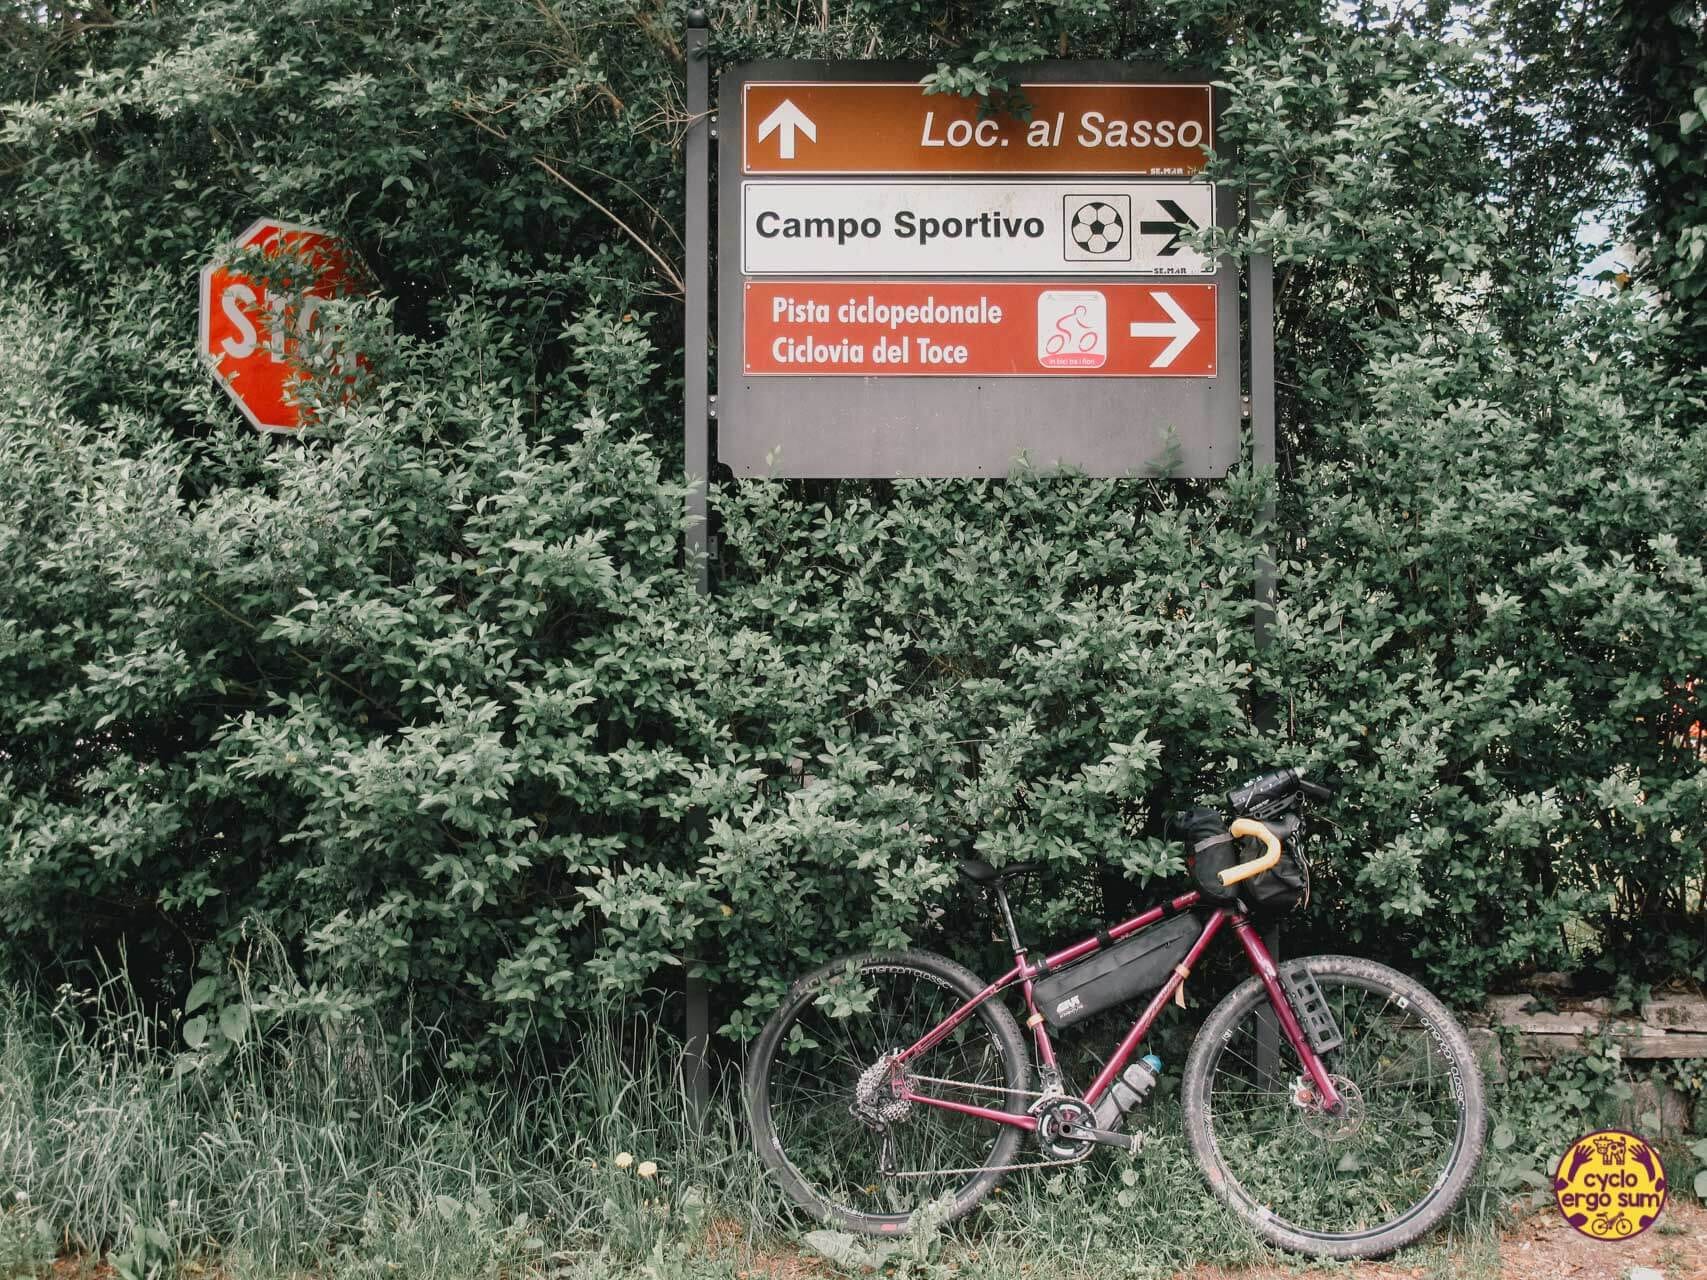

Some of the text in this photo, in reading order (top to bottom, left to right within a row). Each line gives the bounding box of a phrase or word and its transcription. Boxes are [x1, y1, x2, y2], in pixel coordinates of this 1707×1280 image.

[920, 110, 1204, 148] Loc. al Sasso
[755, 210, 1045, 245] Campo Sportivo
[221, 283, 364, 370] STO
[772, 296, 1003, 329] Pista ciclopedonale
[772, 336, 968, 364] Ciclovia del Toce
